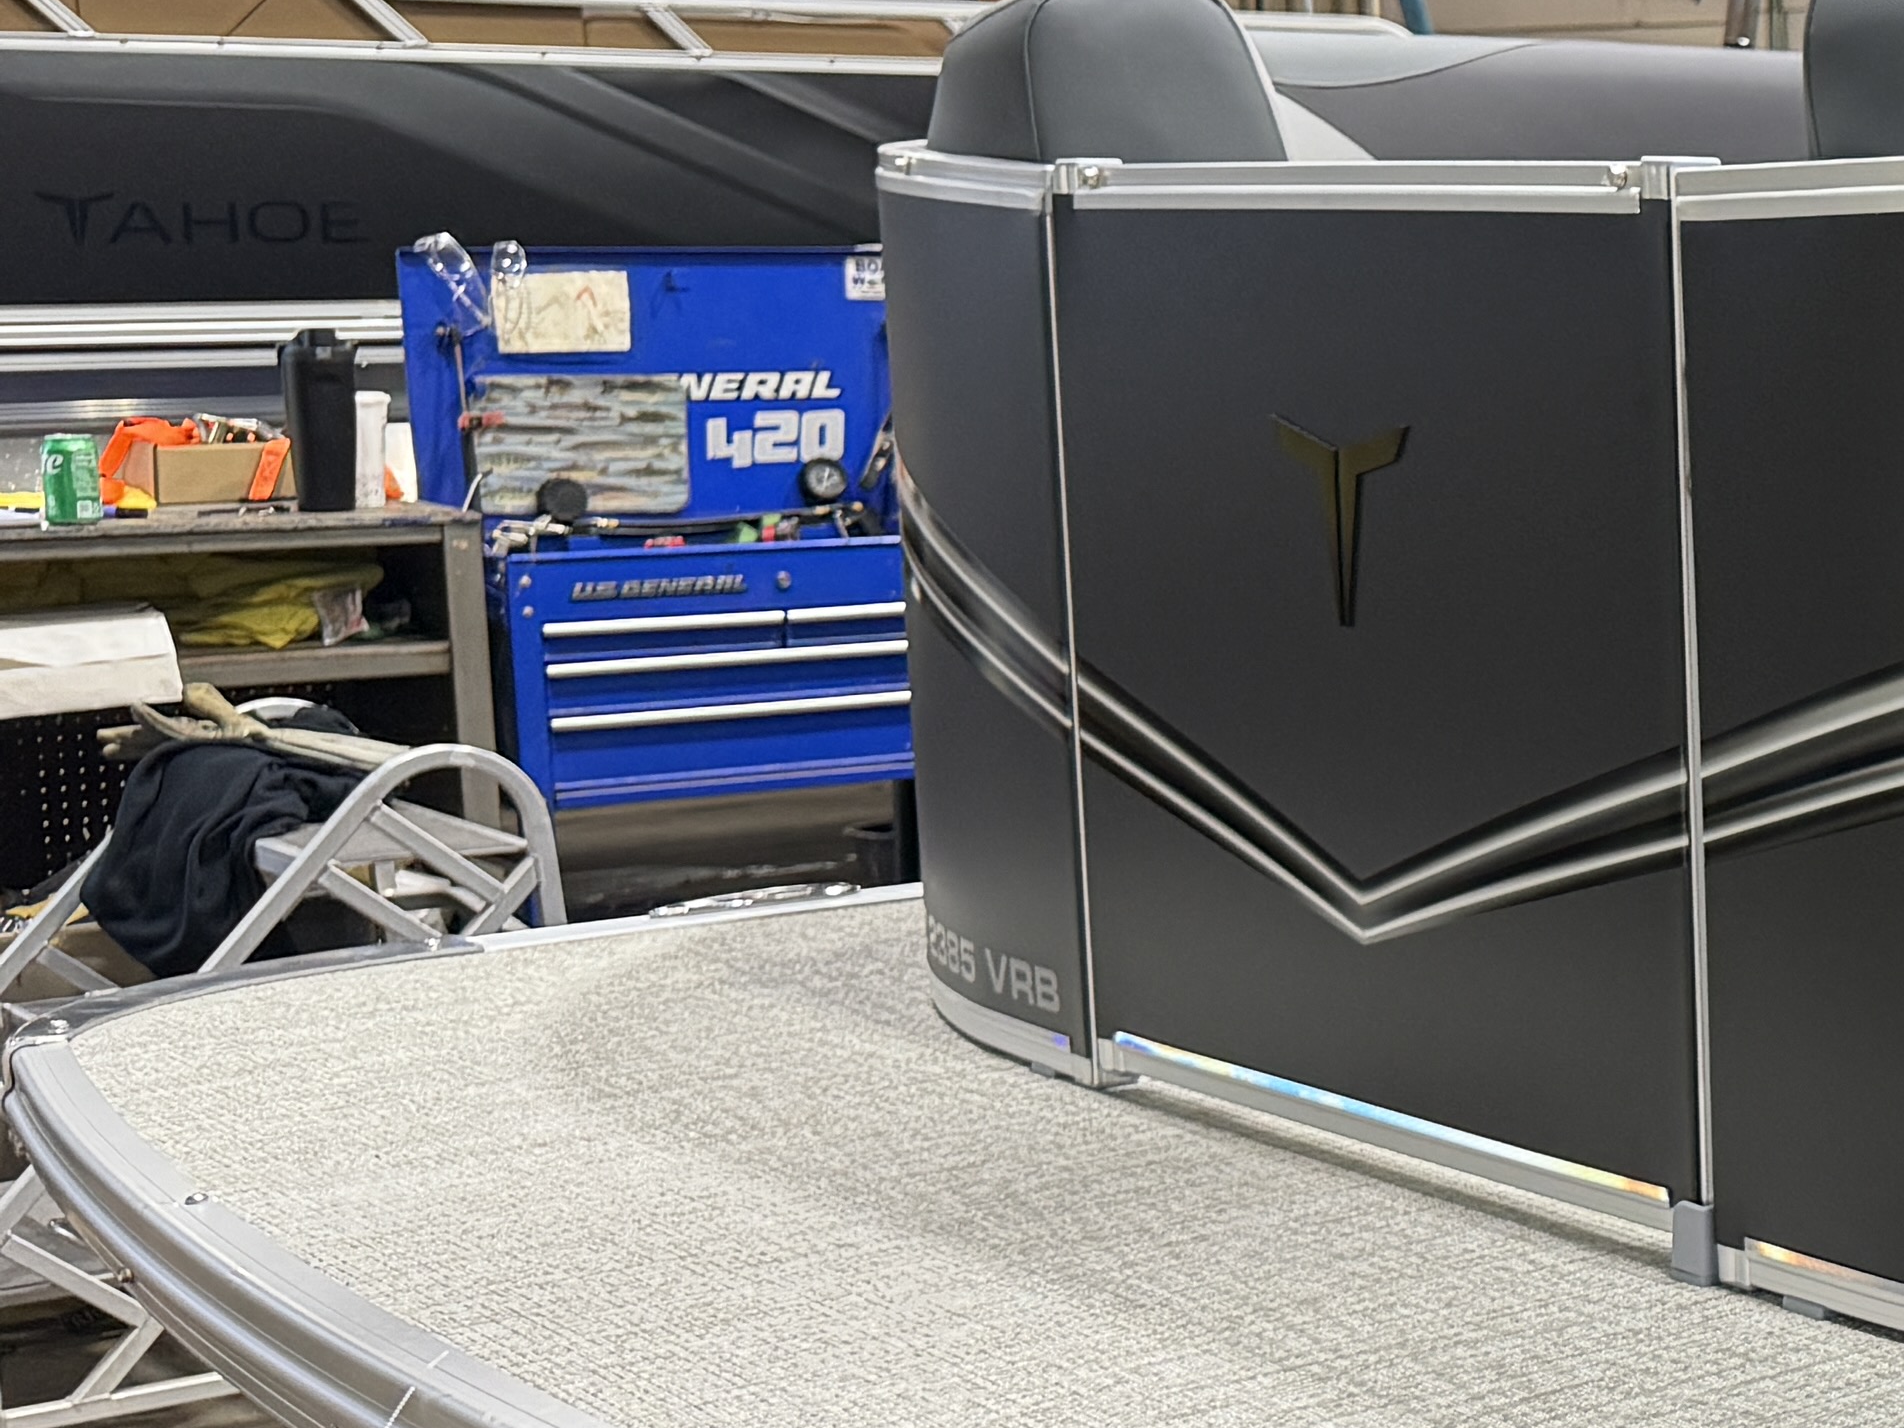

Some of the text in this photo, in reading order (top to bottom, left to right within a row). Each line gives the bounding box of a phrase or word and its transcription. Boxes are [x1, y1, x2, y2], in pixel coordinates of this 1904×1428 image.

[34, 190, 371, 246] TAHOE
[680, 370, 842, 401] NERAL
[706, 408, 845, 469] 420
[984, 947, 1061, 1014] VRB
